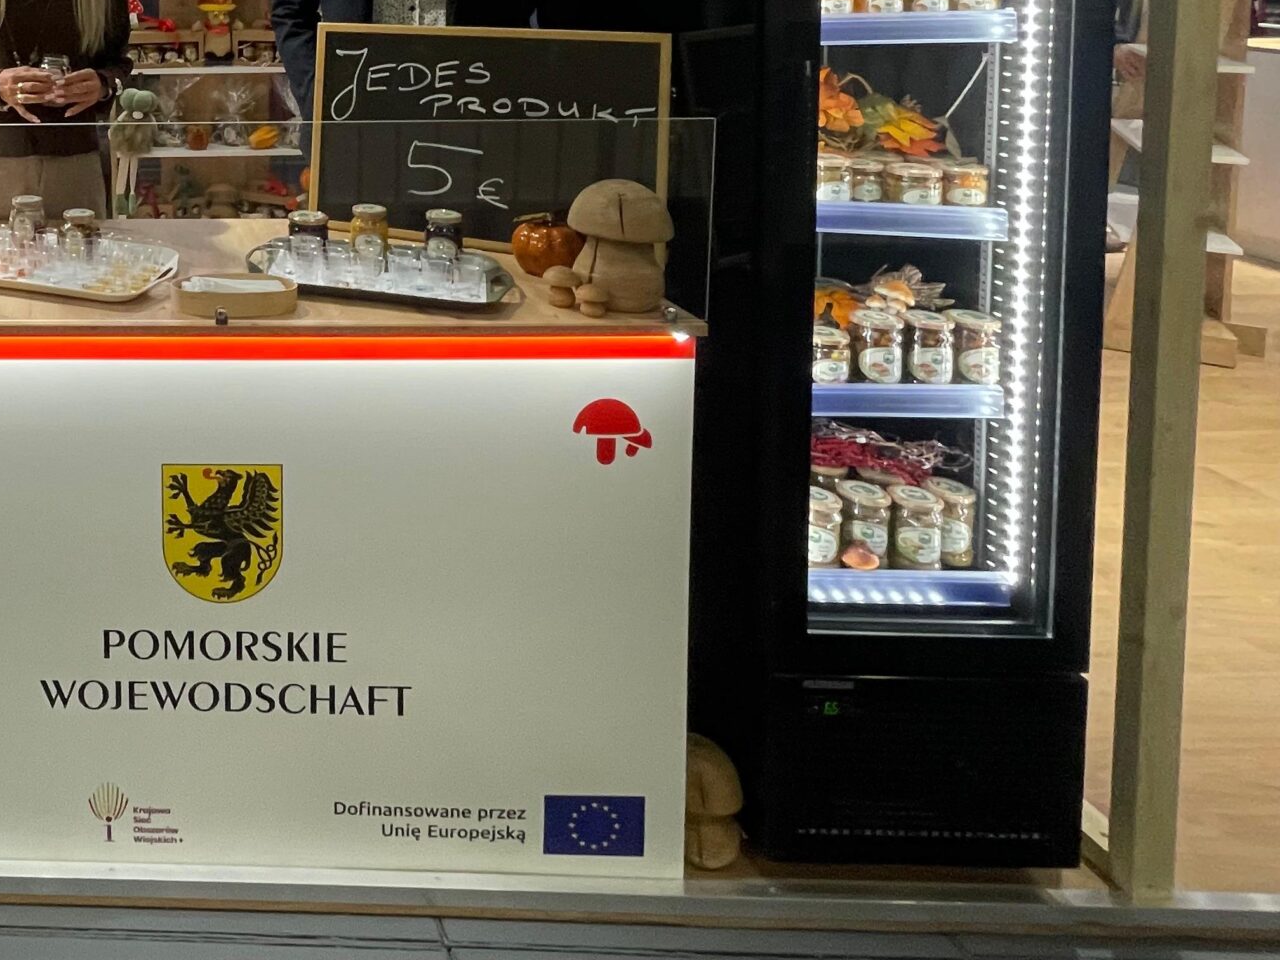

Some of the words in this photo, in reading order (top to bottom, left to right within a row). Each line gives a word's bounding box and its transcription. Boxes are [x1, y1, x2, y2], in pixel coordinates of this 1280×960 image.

[331, 48, 491, 121] JEDES
[420, 94, 656, 127] PRODUKT
[408, 141, 484, 195] 5
[103, 629, 348, 663] POMORSKIE
[40, 680, 412, 716] WOJEWODSCHAFT
[333, 801, 471, 819] Dofinansowane
[477, 807, 527, 823] przez
[381, 823, 421, 841] Unię
[427, 824, 526, 844] Europejską
